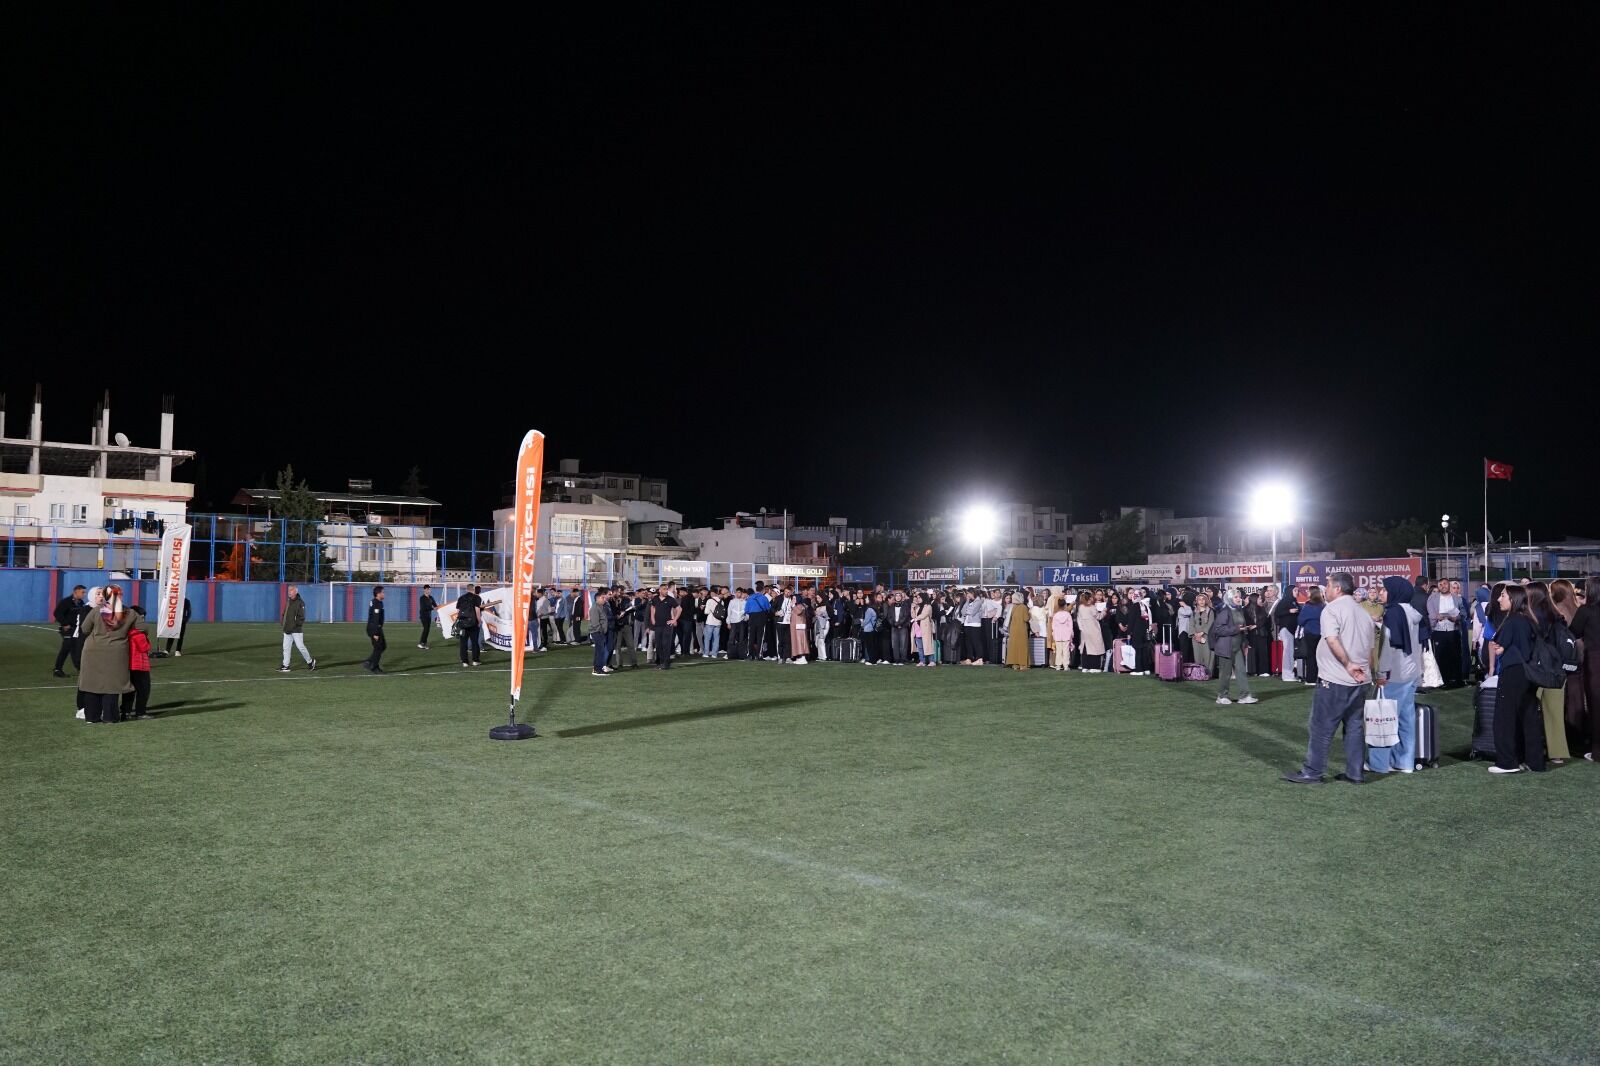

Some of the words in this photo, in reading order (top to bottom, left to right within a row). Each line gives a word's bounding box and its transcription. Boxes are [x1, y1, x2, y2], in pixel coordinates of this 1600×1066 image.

[1198, 565, 1235, 576] BAYKURT
[1237, 564, 1270, 575] TEKSTİL
[1366, 564, 1411, 573] GURURUNA
[1070, 573, 1099, 582] Tekstil
